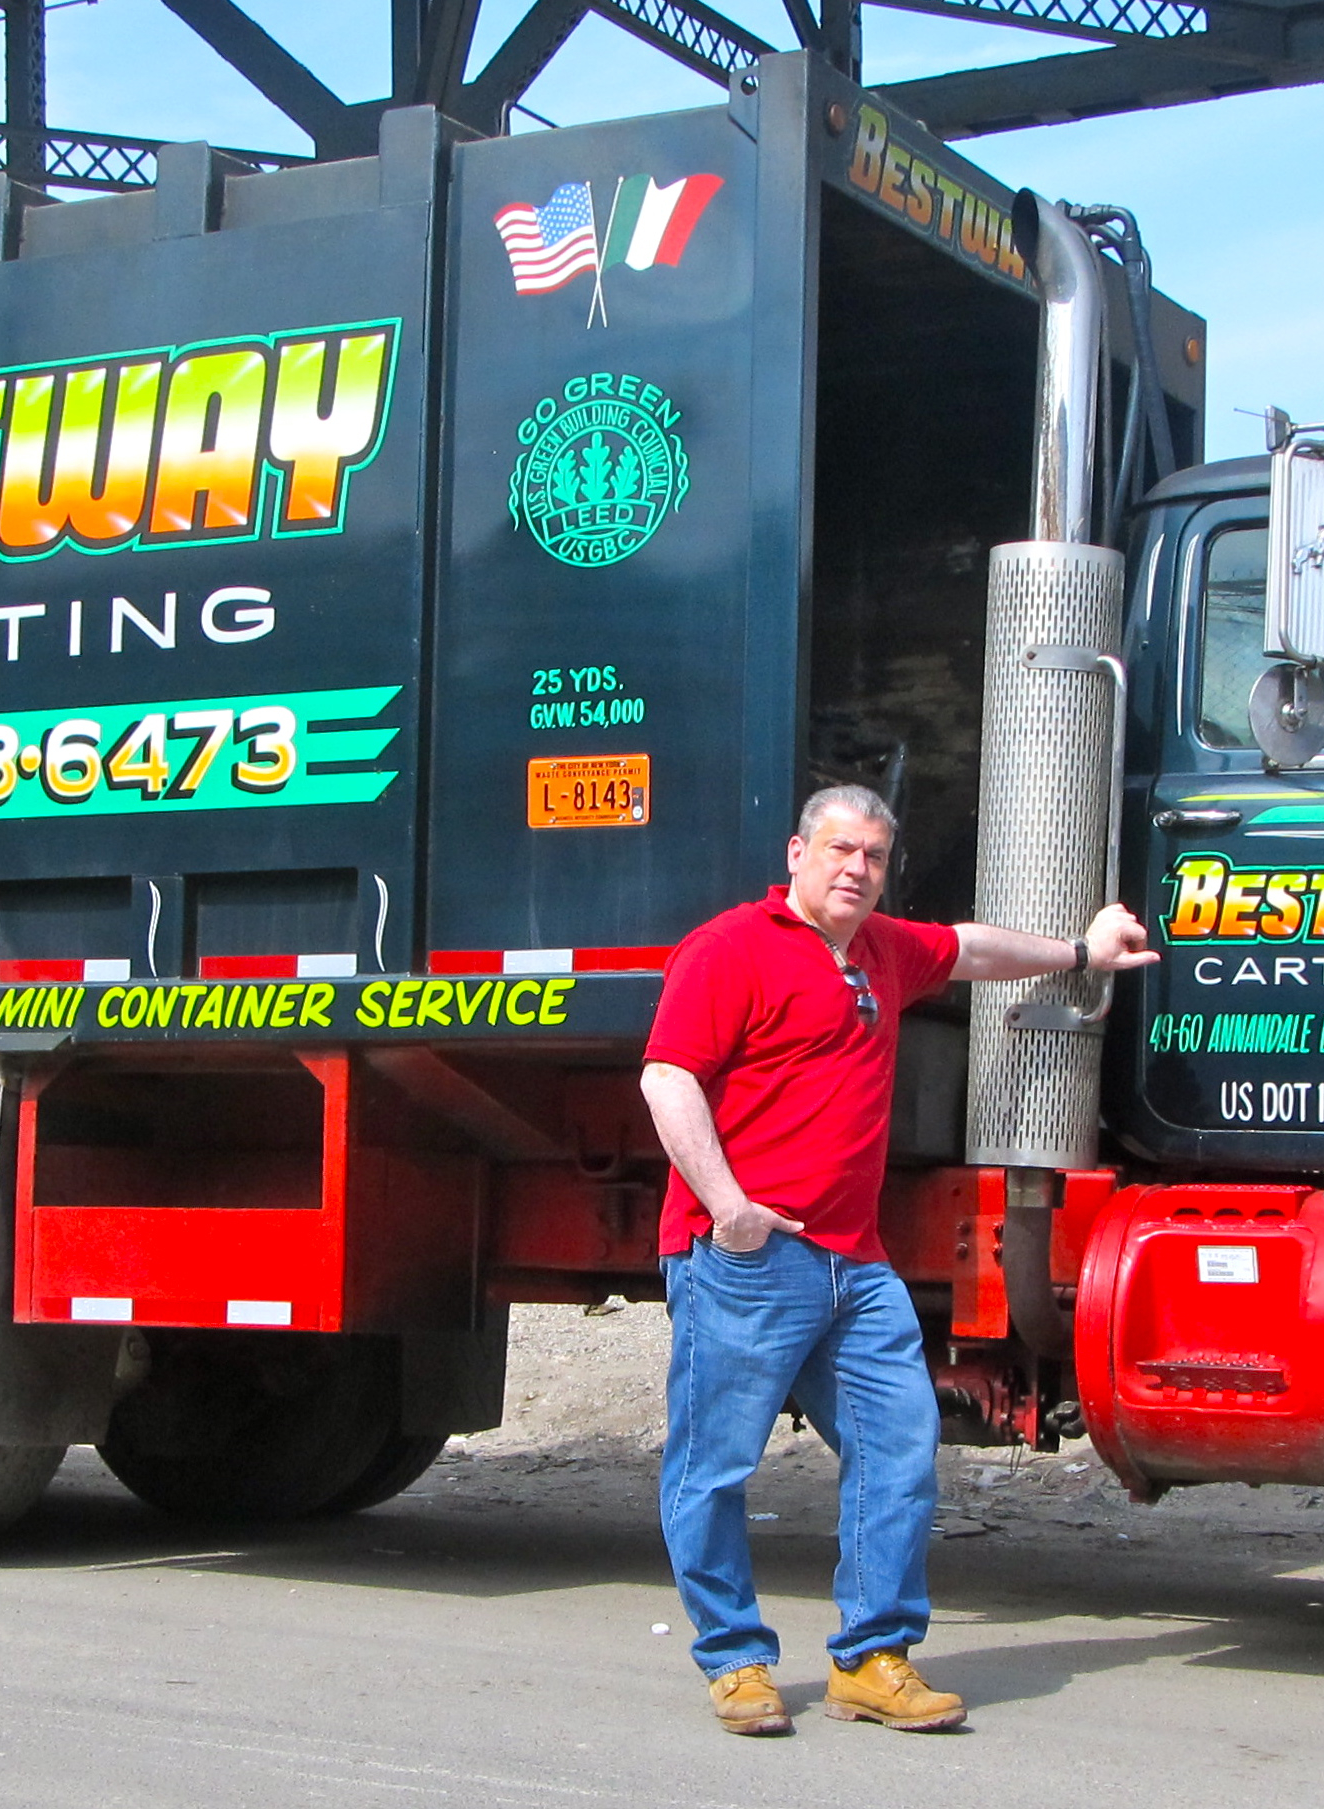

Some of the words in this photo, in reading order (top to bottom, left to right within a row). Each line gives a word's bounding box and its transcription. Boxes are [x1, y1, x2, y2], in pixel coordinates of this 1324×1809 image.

[848, 103, 1038, 288] BESTWA
[517, 397, 557, 445] GO
[564, 372, 682, 429] GREEN
[530, 430, 563, 484] GREEN
[559, 404, 631, 437] BUILDING
[561, 504, 634, 532] LEED
[559, 530, 637, 562] USGBC
[532, 668, 563, 696] 25
[569, 665, 625, 693] YDS.
[579, 697, 645, 730] 54,000
[543, 780, 631, 812] L-8143
[97, 982, 336, 1029] CONTAINER
[355, 978, 577, 1028] SERVICE
[1149, 1013, 1205, 1054] 49-60
[1206, 1013, 1316, 1054] ANNANDALE
[1220, 1081, 1254, 1122] US
[1261, 1082, 1313, 1123] DOT
